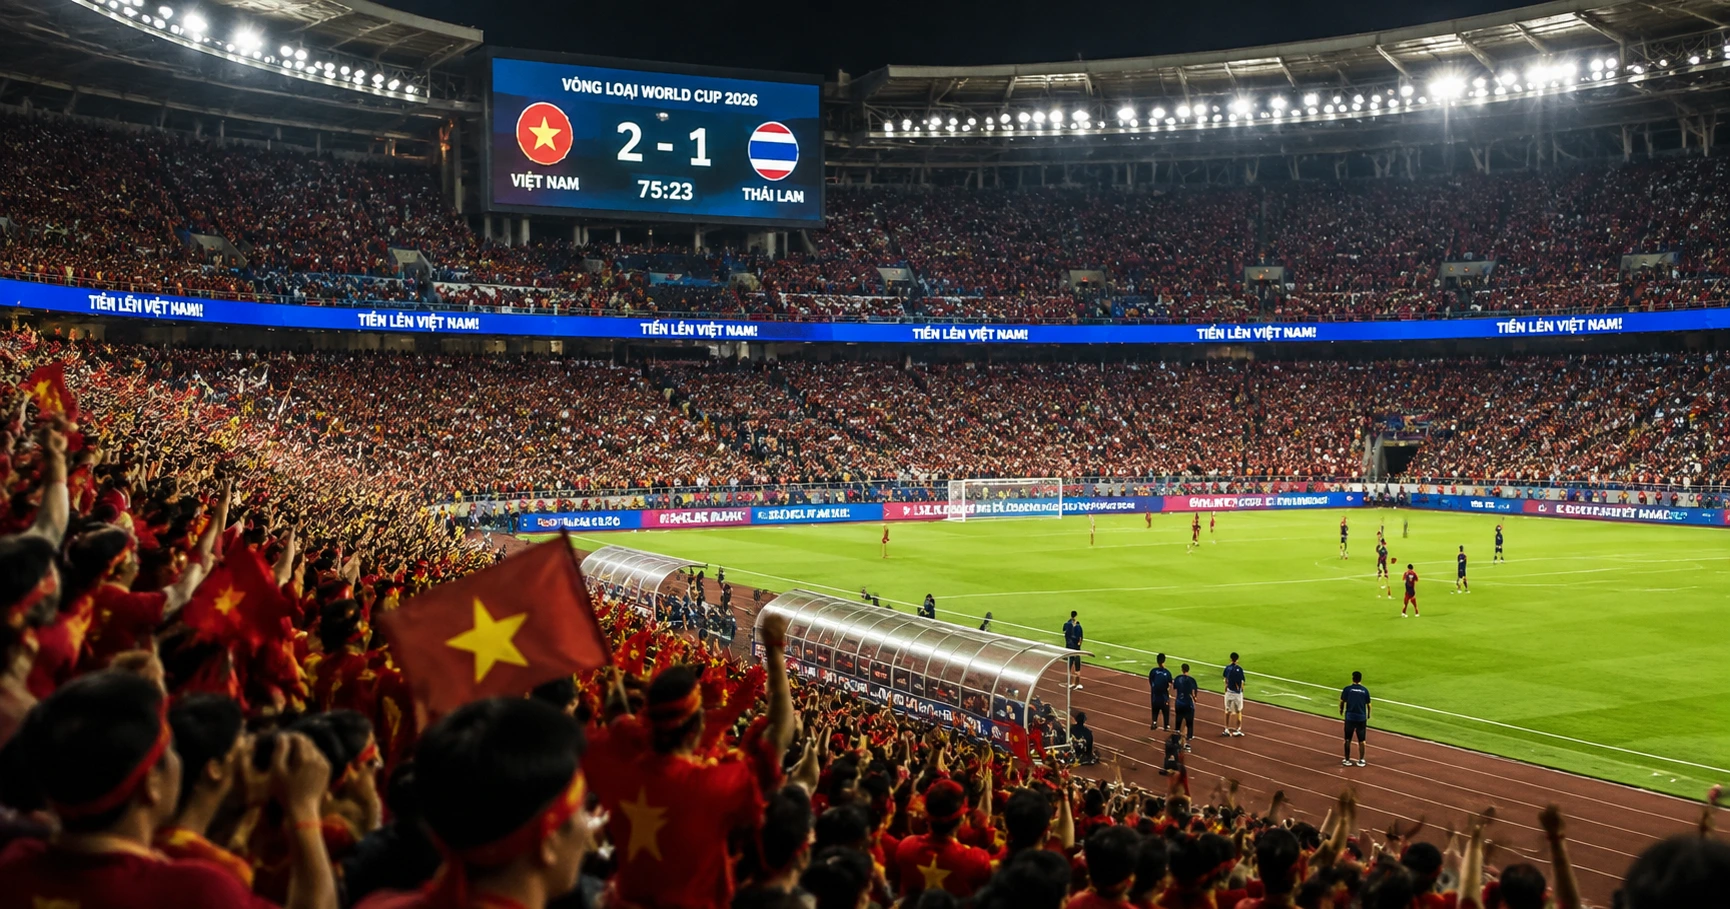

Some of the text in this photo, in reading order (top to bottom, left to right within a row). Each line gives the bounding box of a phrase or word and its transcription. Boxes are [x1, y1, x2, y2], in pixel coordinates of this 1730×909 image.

[640, 84, 692, 102] WORLD
[693, 89, 723, 104] CUP
[724, 91, 759, 107] 2026
[617, 121, 712, 167] 2 - 1
[510, 170, 580, 192] VIỆT NAM
[637, 179, 693, 201] 75:23
[446, 316, 480, 330] NAM!
[1587, 317, 1623, 331] NAM!
[725, 324, 758, 337] NAM!
[996, 329, 1029, 341] NAM!
[1283, 326, 1317, 338] NAM!
